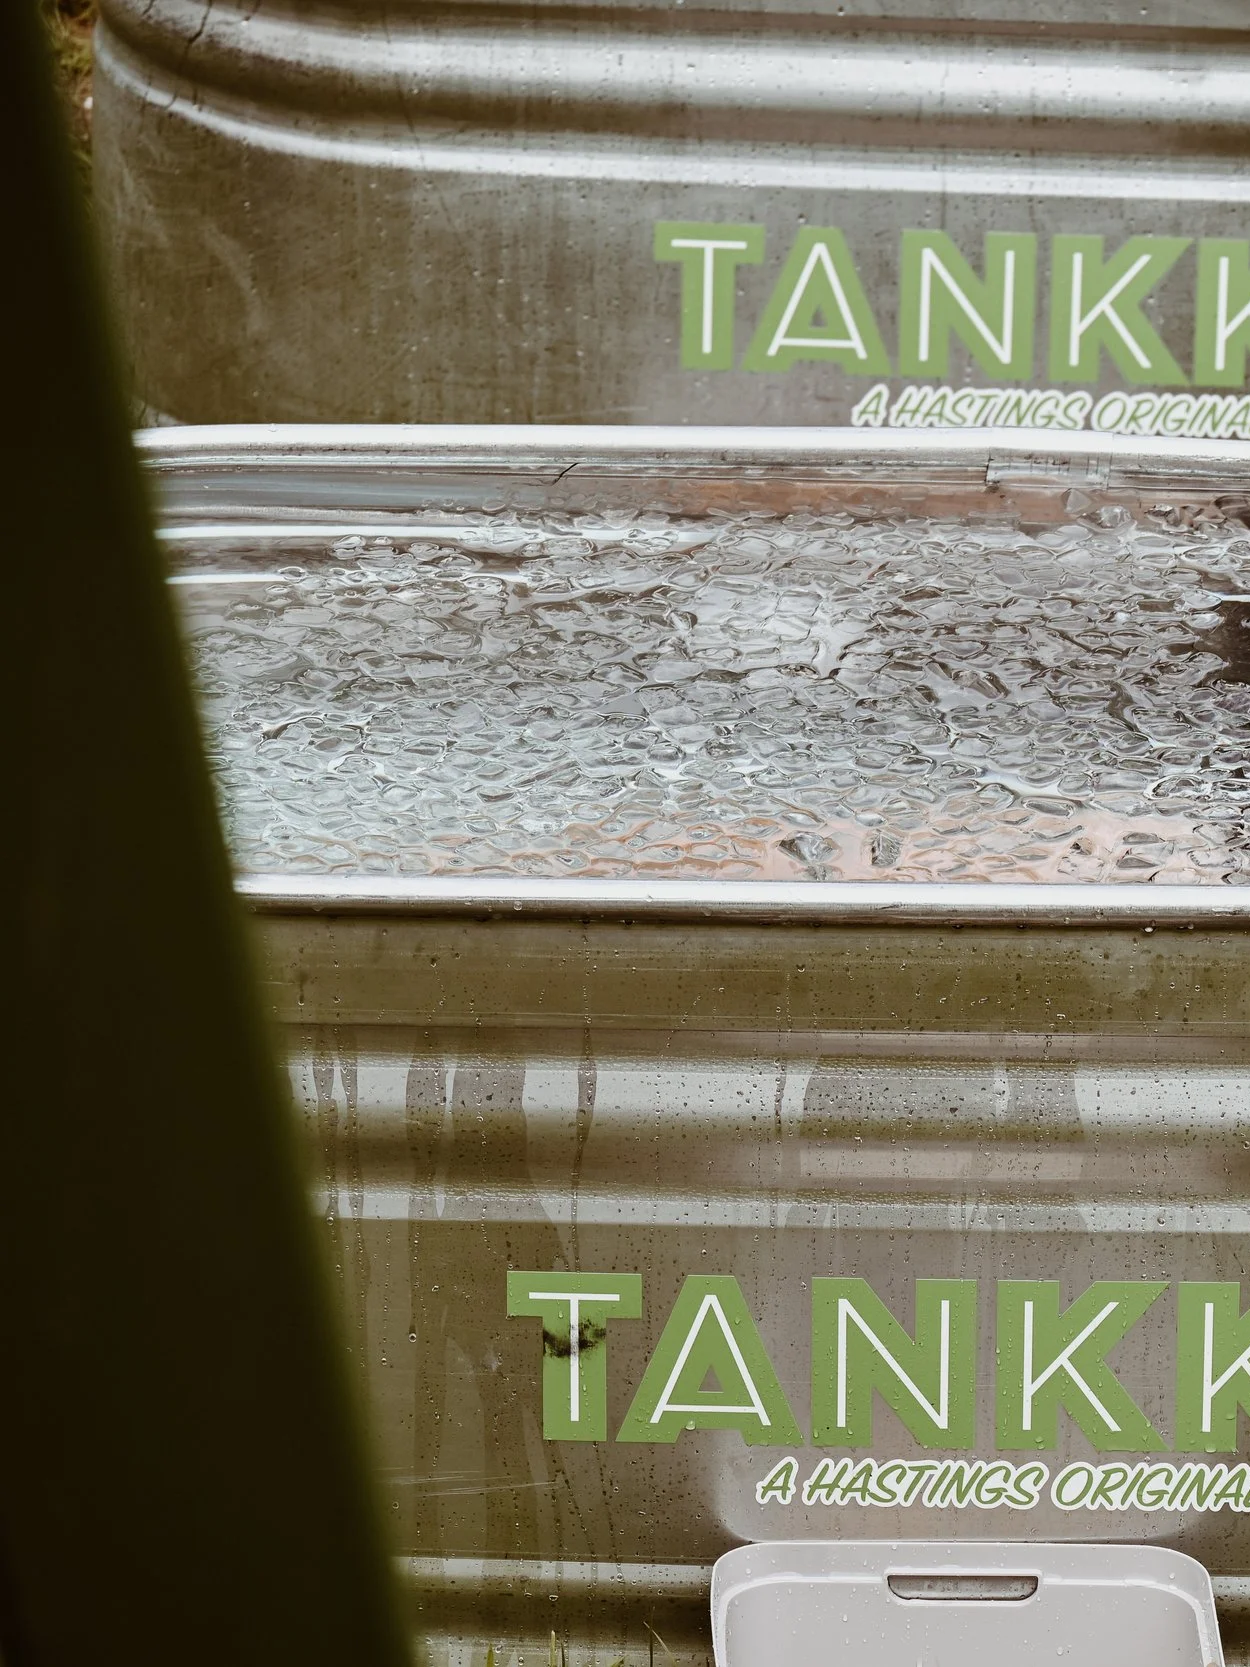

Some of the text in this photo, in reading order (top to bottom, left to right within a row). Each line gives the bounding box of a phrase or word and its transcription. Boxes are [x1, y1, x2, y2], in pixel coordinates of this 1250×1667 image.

[855, 387, 887, 425] A
[892, 389, 1089, 430] HASTINGS
[758, 1459, 797, 1502] A
[804, 1460, 1046, 1507] HASTINGS
